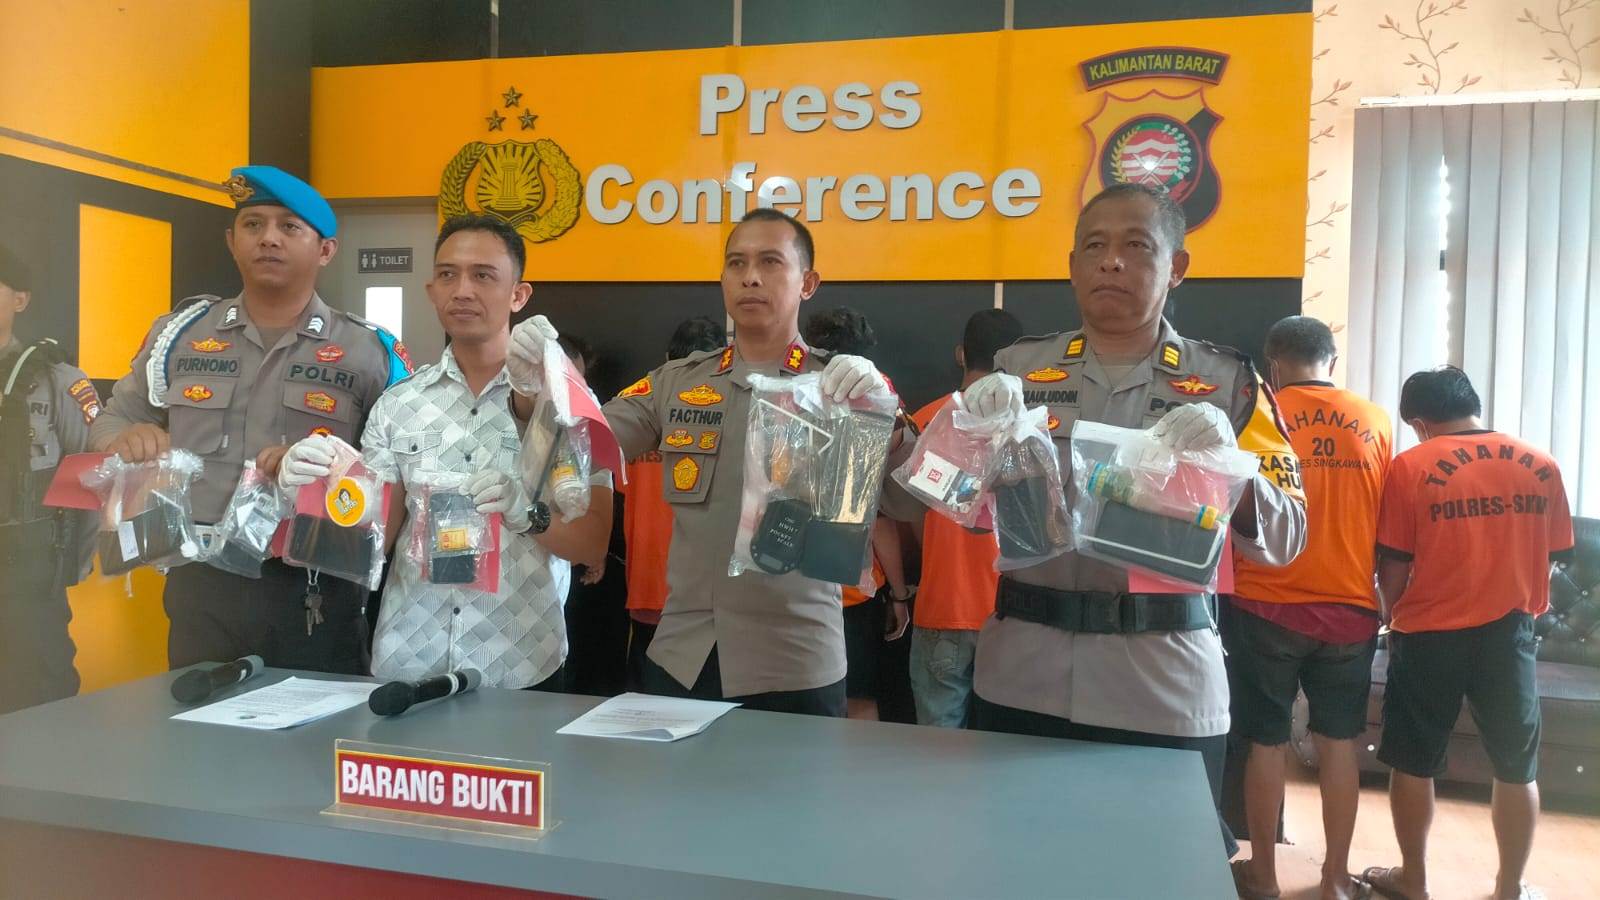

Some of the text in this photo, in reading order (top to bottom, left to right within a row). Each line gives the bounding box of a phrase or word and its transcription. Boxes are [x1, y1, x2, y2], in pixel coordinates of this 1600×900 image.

[1089, 54, 1220, 80] KALIMANTAN BARAT
[700, 74, 922, 135] Press
[585, 162, 1041, 224] Conference
[379, 256, 409, 265] TOILET
[176, 357, 238, 373] PURNOMO
[290, 364, 356, 388] POLRI
[669, 408, 723, 425] FACTHUR
[1286, 408, 1375, 443] AHANAN
[1311, 437, 1335, 457] 20
[1425, 444, 1552, 487] TAHANAN
[1276, 472, 1301, 490] HU
[341, 760, 533, 816] BARANG BUKTI
